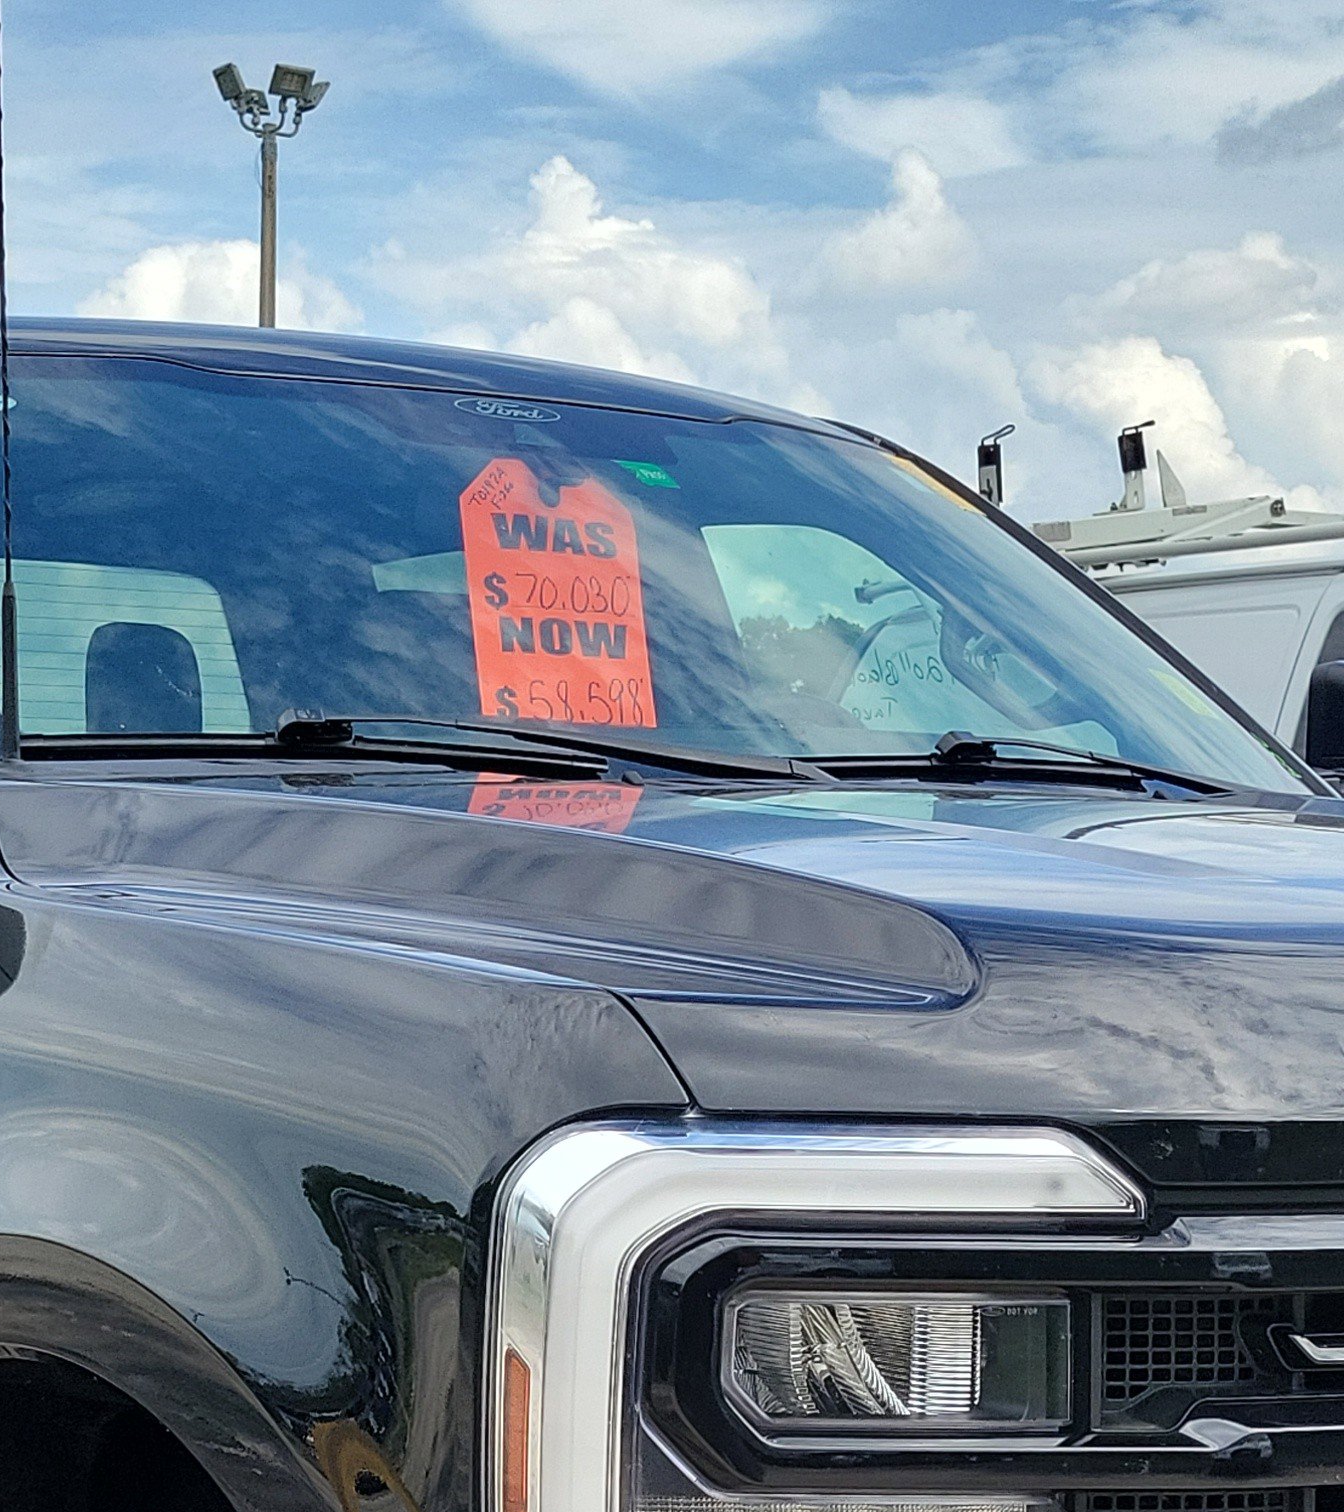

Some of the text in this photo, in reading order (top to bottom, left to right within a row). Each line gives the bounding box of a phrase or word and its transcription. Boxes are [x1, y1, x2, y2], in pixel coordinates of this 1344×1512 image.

[476, 399, 544, 419] Ford
[490, 512, 617, 558] WAS
[484, 571, 509, 611] $
[499, 616, 628, 660] NOW
[495, 686, 519, 724] $
